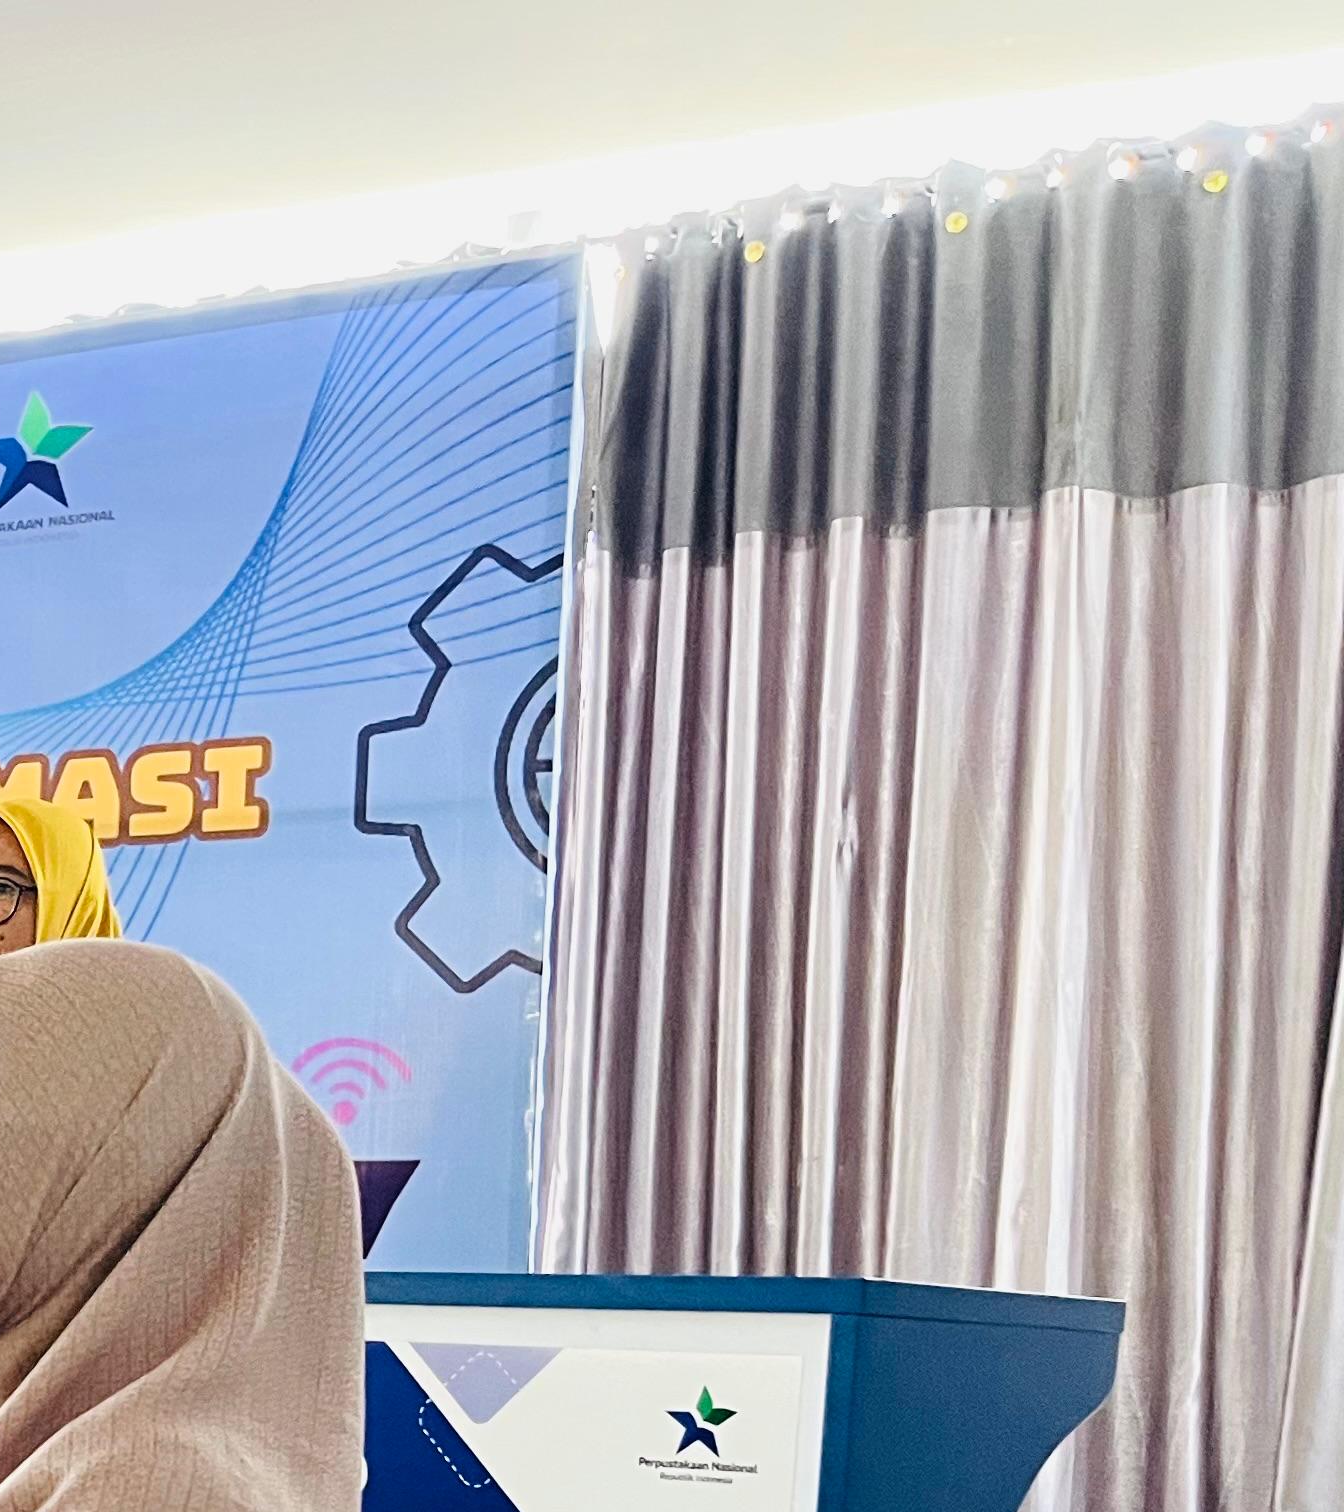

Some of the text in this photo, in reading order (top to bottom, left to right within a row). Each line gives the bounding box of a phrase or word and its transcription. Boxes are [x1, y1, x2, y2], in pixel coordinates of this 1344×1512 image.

[48, 510, 116, 527] NASIONAL
[638, 1456, 758, 1474] Perpustakaan Nasional
